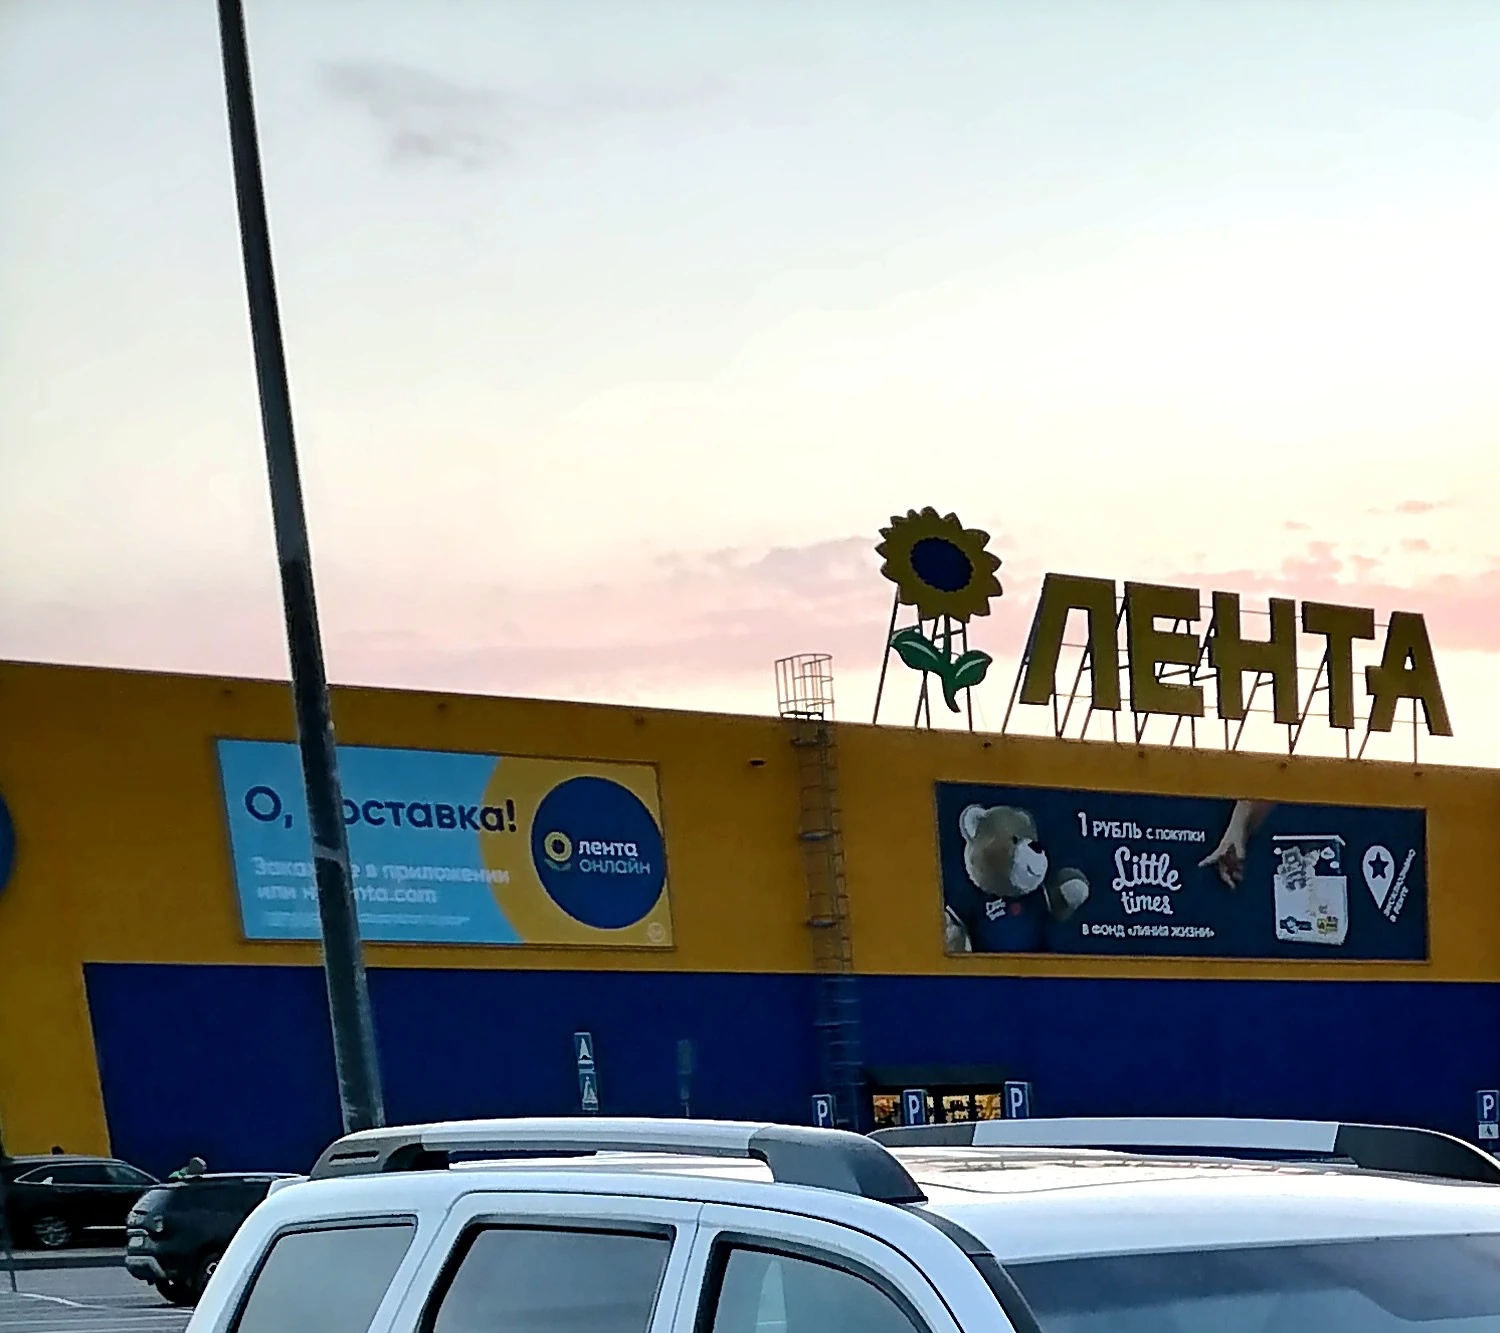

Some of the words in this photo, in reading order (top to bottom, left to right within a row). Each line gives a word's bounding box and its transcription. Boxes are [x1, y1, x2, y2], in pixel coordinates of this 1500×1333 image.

[1019, 573, 1454, 737] ЛЕНТА
[244, 785, 293, 829] О,
[342, 798, 517, 833] оставка!
[1077, 811, 1088, 837] 1
[1092, 820, 1142, 839] РУБЛЬ
[1155, 828, 1206, 843] ПОКУПКИ
[578, 841, 639, 858] лента
[579, 857, 651, 875] онлайн
[1112, 845, 1182, 892] Little
[1121, 890, 1174, 915] times
[1091, 923, 1126, 938] ФОНД
[817, 1099, 828, 1126] P
[908, 1094, 920, 1125] P
[1010, 1087, 1023, 1118] P
[1483, 1094, 1495, 1119] P
